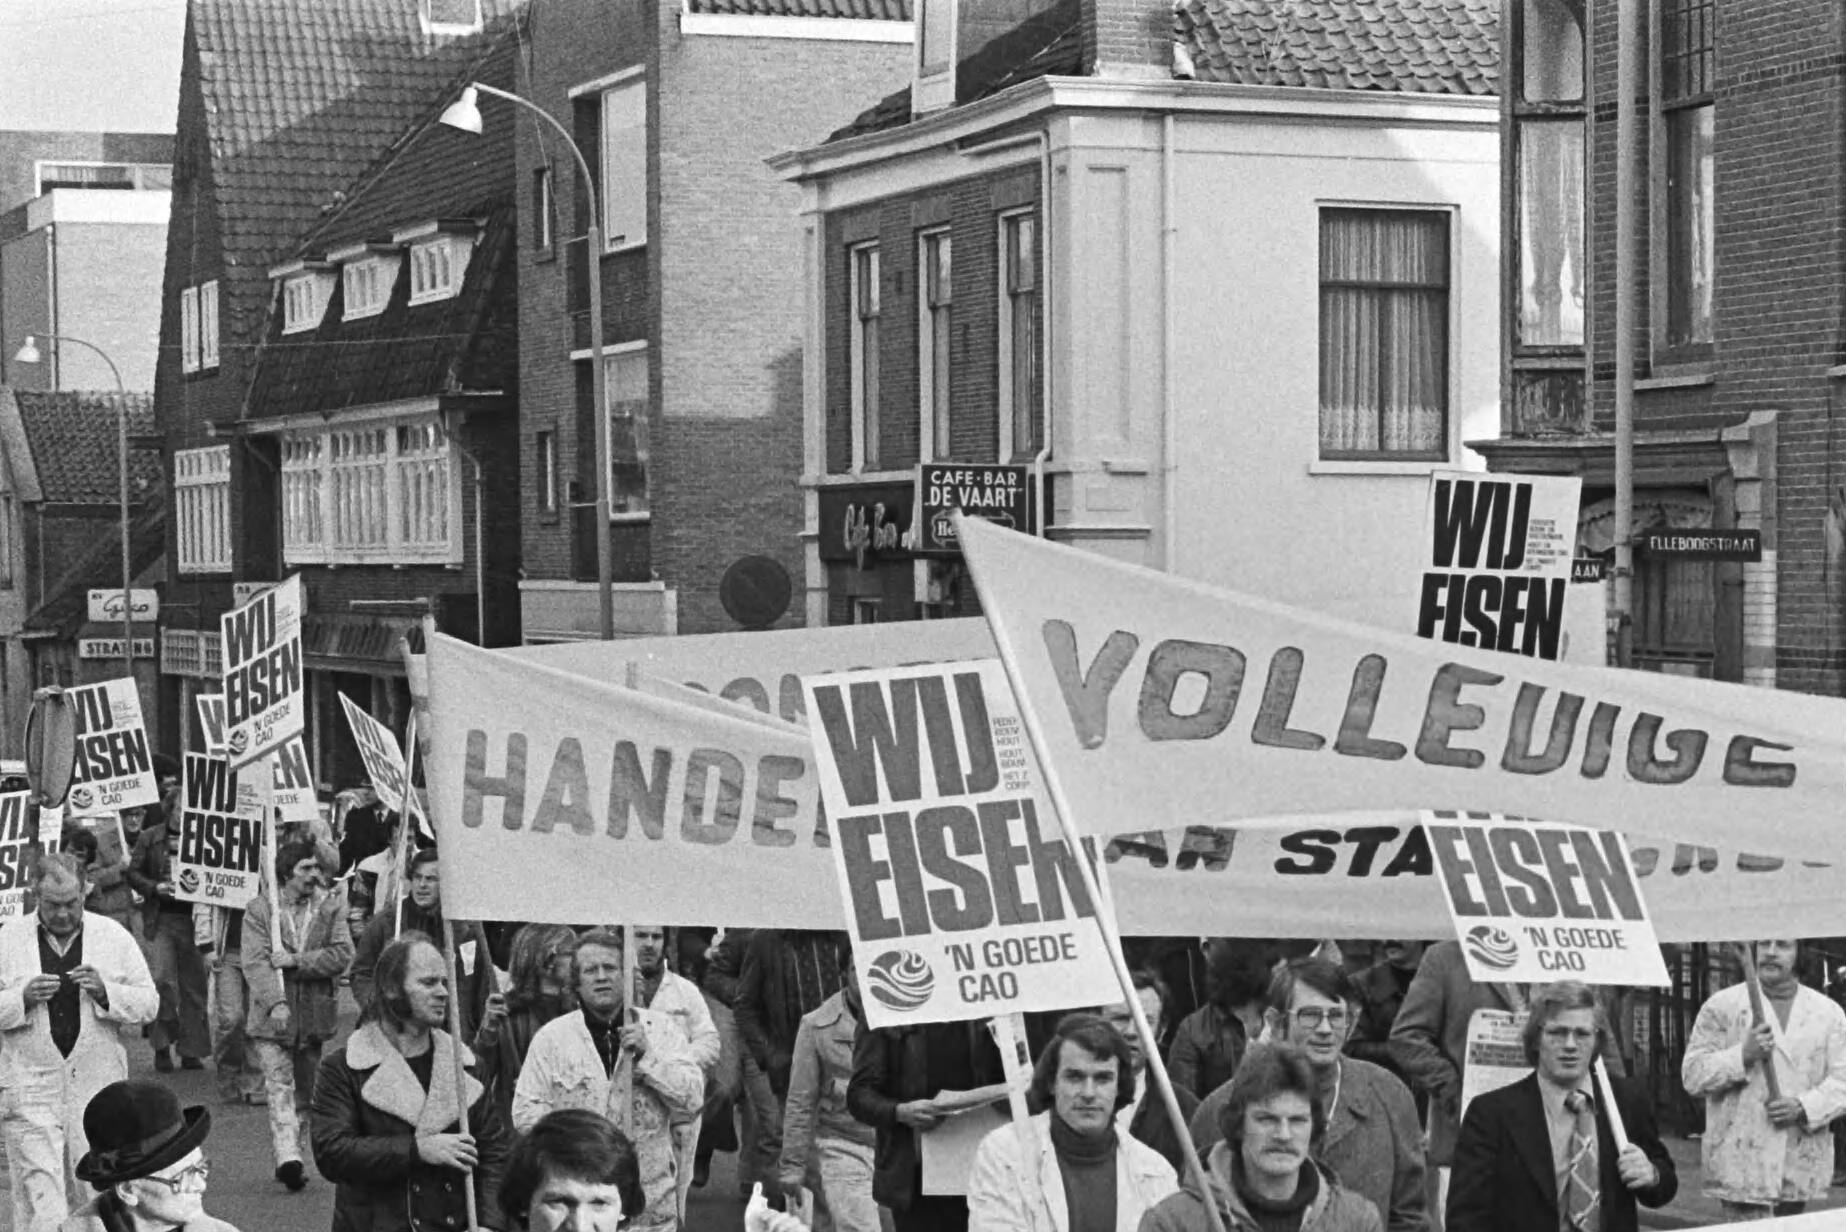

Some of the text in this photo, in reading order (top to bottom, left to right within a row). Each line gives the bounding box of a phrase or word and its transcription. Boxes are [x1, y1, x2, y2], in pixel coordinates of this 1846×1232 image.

[1433, 479, 1533, 570] WIJ
[1650, 536, 1755, 552] ELLEBOOGSTRAAT
[225, 592, 277, 669] WIJ
[1417, 572, 1567, 661] EISEN
[226, 637, 301, 728] EISEN
[74, 686, 114, 735] IJ
[73, 728, 151, 784] ISEN
[255, 730, 273, 746] CAO
[813, 672, 1000, 807] WIJ
[101, 794, 123, 806] CAO
[109, 778, 142, 793] GOEDE
[185, 754, 238, 814] WIJ
[180, 811, 262, 873] EISEN
[206, 886, 225, 899] CAO
[216, 873, 247, 889] GOEDE
[837, 798, 1100, 942] EISEN
[1429, 825, 1645, 921] EISEN
[982, 933, 1078, 965] GOEDE
[1539, 950, 1585, 972] CAO
[1554, 927, 1628, 951] GOEDE
[959, 971, 1019, 1004] CAO
